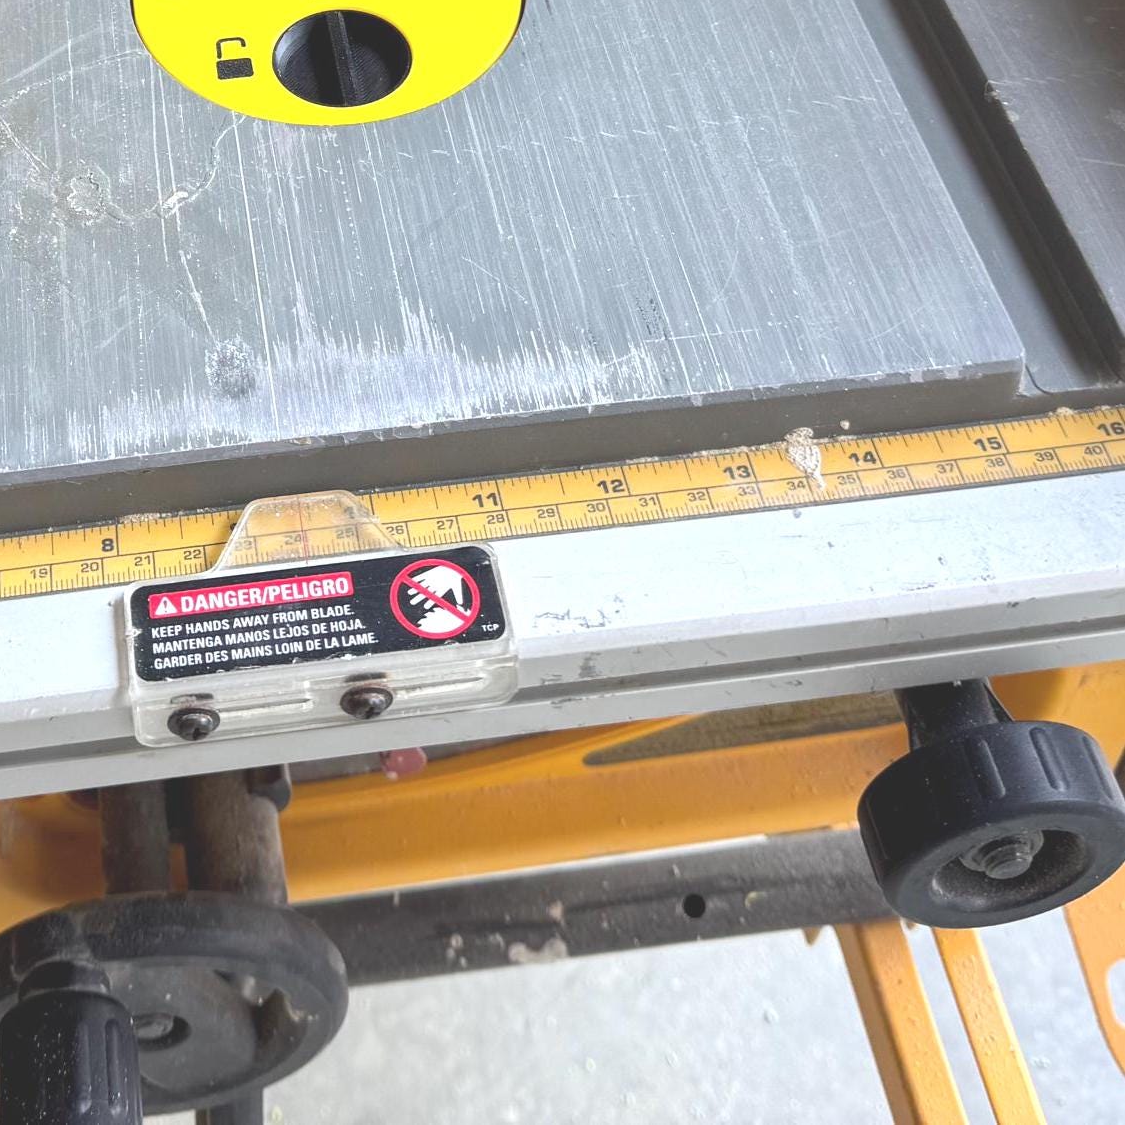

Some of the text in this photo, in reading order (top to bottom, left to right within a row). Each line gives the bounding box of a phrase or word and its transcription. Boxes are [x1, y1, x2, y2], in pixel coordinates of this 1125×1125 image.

[101, 538, 114, 552] 8
[472, 493, 498, 508] 11
[597, 479, 625, 494] 12
[723, 465, 751, 480] 13
[848, 451, 876, 466] 14
[974, 437, 1002, 452] 15
[1097, 422, 1125, 436] 16
[30, 568, 48, 579] 19
[81, 562, 99, 572] 20
[134, 555, 151, 566] 21
[183, 549, 202, 560] 22
[285, 534, 301, 545] 24
[337, 528, 354, 539] 25
[386, 525, 404, 535] 26
[436, 519, 454, 530] 27
[487, 514, 505, 525] 28
[537, 508, 556, 519] 29
[587, 502, 606, 513] 30
[638, 496, 657, 507] 31
[687, 491, 706, 502] 32
[738, 486, 756, 496] 33
[787, 481, 806, 491] 34
[837, 474, 856, 485] 35
[887, 469, 906, 480] 36
[936, 463, 955, 474] 37
[986, 457, 1005, 468] 38
[1035, 452, 1054, 462] 39
[1084, 445, 1102, 456] 40
[180, 577, 349, 613] DANGER/PELIGRO
[151, 604, 355, 639] KEEP HANDS AWAY FROM BLADE.
[152, 618, 366, 654] MANTENGA MANOS LEJOS DE HOJA.
[481, 623, 500, 632] TCP
[154, 632, 379, 670] GARDER DES MAINS LOIN DE LA LAME.
